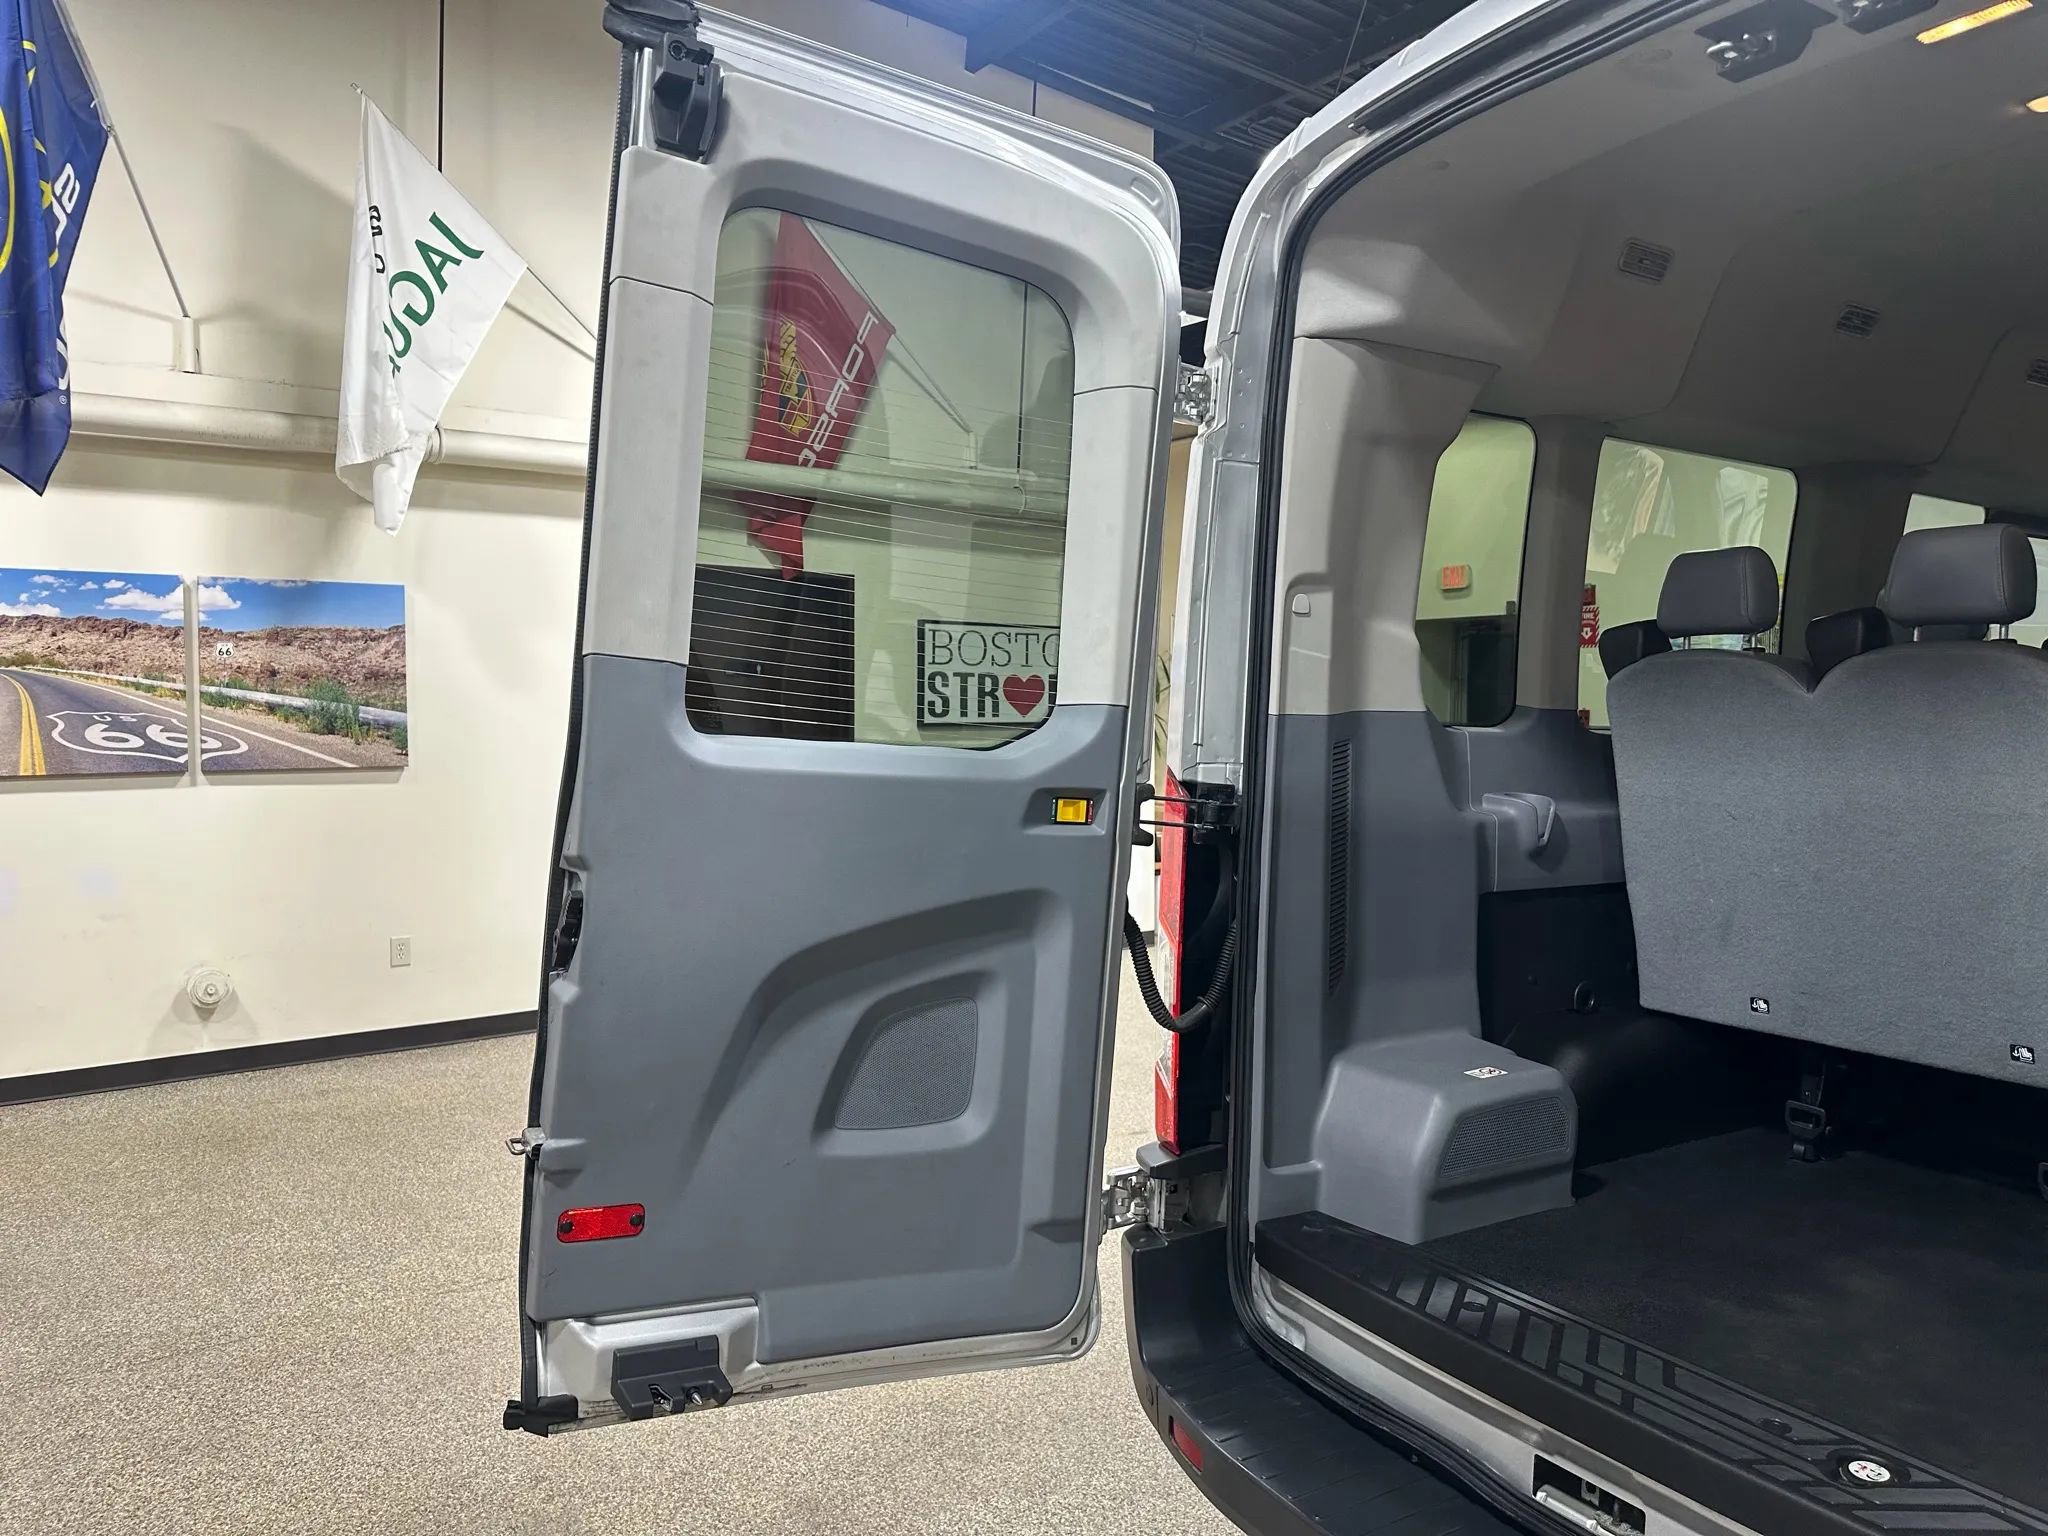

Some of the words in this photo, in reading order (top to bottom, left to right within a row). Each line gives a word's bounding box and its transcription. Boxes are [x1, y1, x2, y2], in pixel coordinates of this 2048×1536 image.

[218, 647, 232, 656] 66
[92, 714, 138, 722] US
[84, 723, 222, 749] 66
